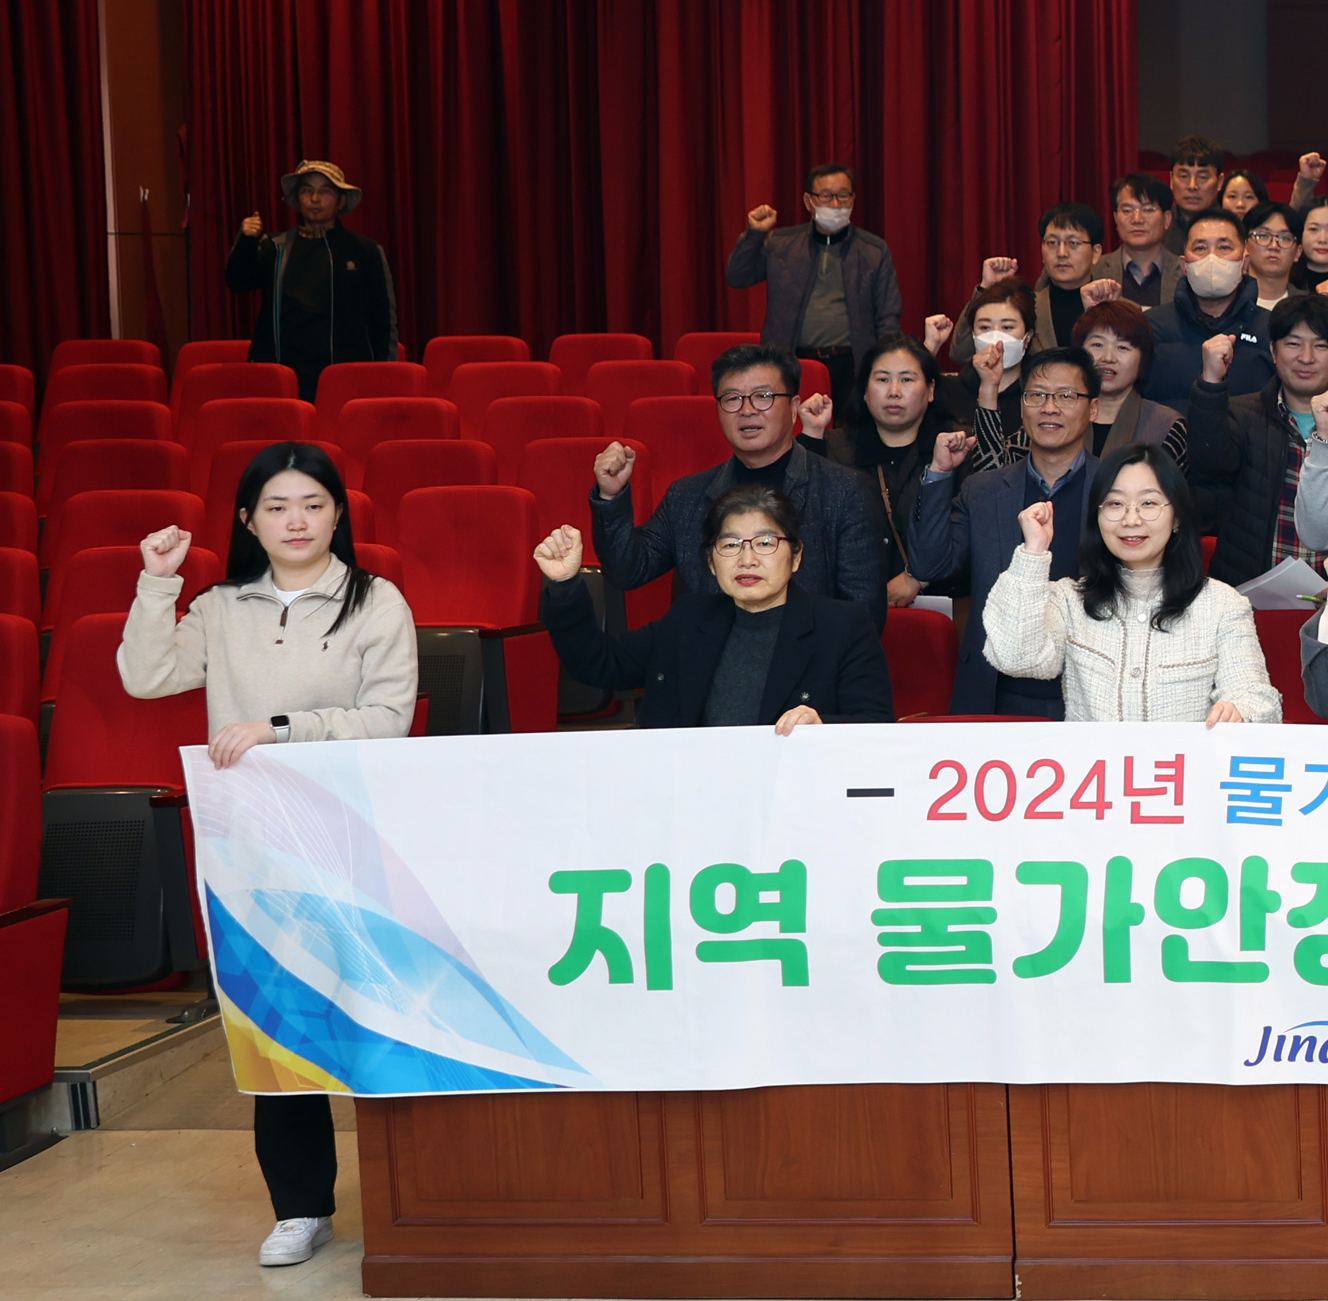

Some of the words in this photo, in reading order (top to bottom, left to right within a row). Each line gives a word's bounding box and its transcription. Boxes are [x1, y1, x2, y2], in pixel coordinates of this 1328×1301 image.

[1240, 333, 1257, 343] FILA
[927, 754, 1184, 824] 2024년
[548, 860, 809, 990] 지역
